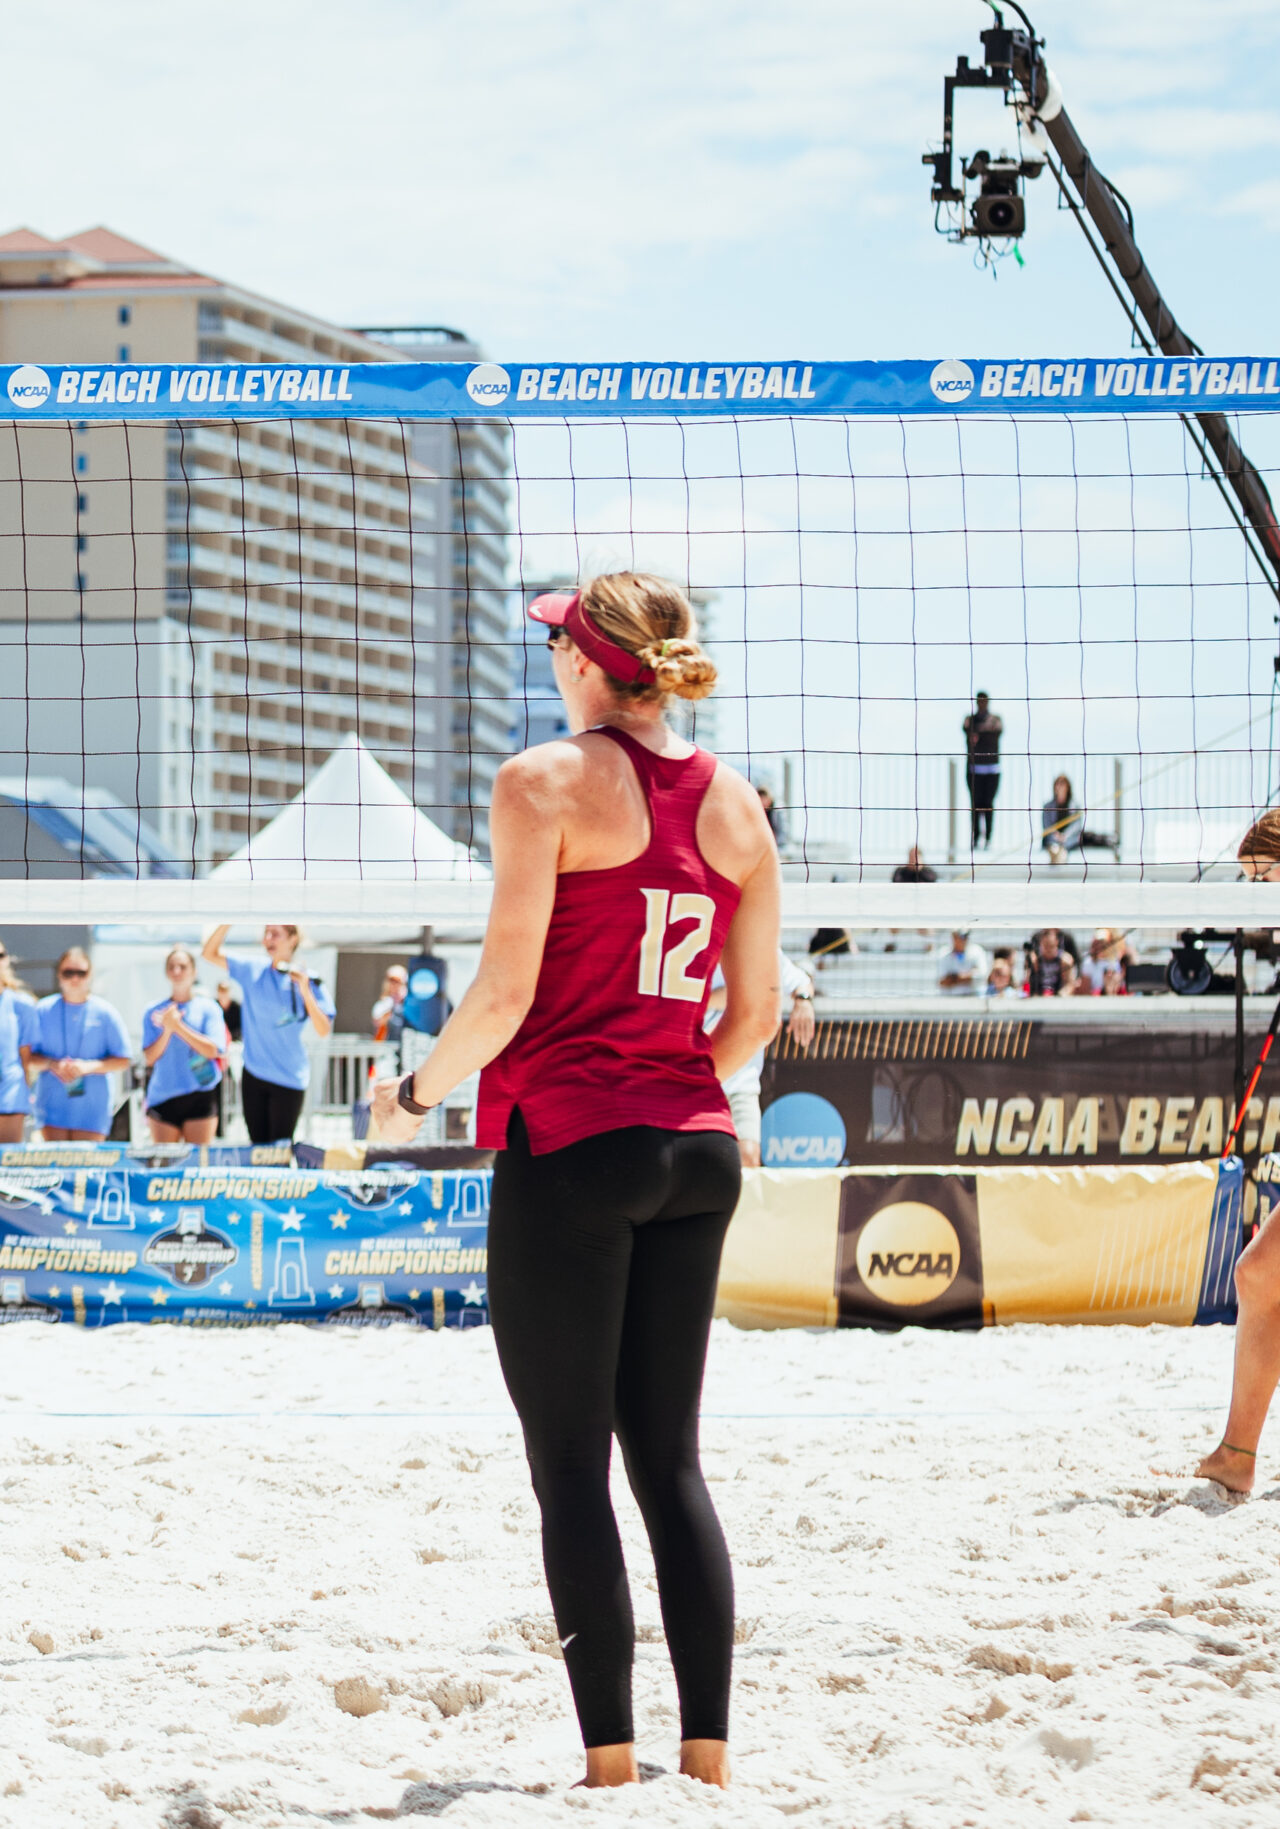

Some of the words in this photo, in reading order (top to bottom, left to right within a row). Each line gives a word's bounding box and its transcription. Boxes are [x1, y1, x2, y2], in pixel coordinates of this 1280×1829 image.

[13, 386, 49, 397] NCAA
[56, 370, 162, 403] BEACH
[169, 369, 353, 402] VOLLEYBALL
[472, 383, 508, 395] NCAA
[516, 368, 623, 401] BEACH
[631, 366, 816, 400] VOLLEYBALL
[936, 380, 972, 392] NCAA
[980, 364, 1087, 397] BEACH
[1095, 362, 1280, 396] VOLLEYBALL
[637, 887, 717, 1003] 12
[956, 1097, 1099, 1156] NCAA
[766, 1136, 842, 1161] NCAA
[146, 1177, 318, 1201] CHAMPIONSHIP
[868, 1253, 954, 1279] NCAA
